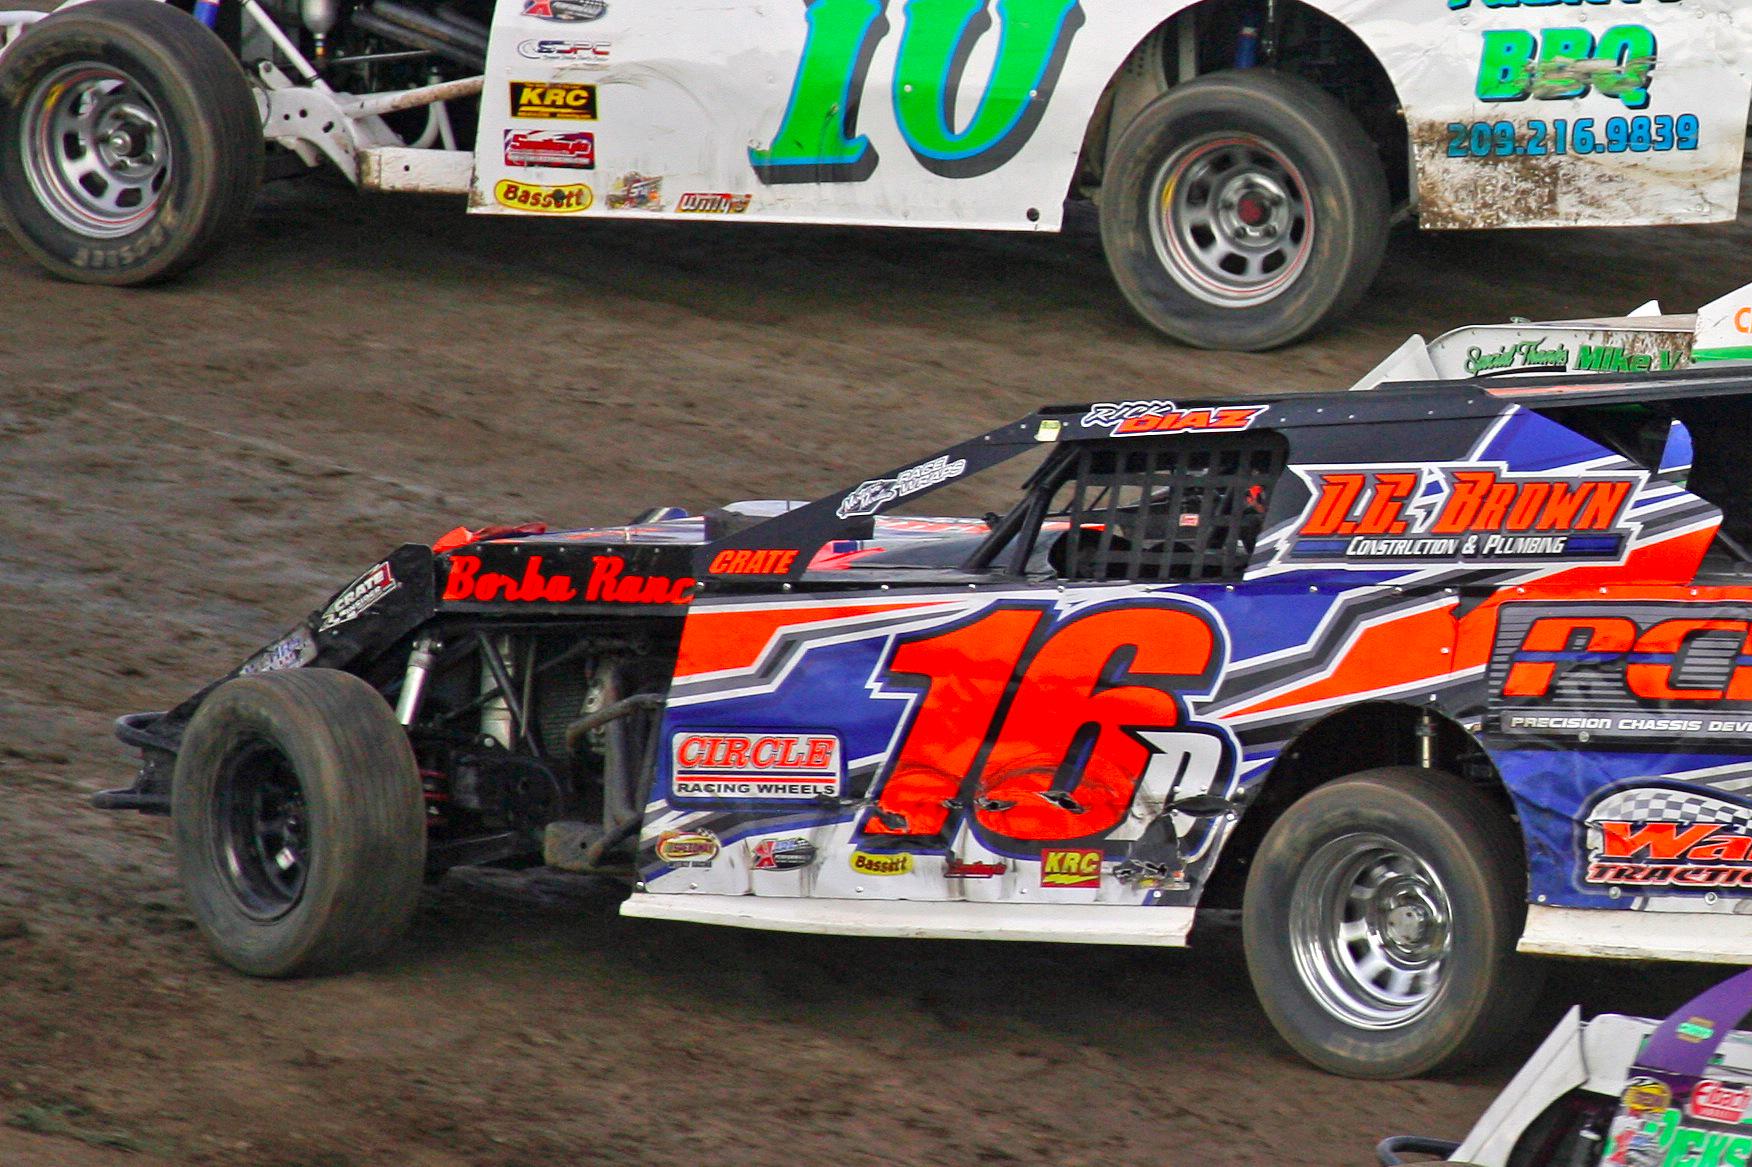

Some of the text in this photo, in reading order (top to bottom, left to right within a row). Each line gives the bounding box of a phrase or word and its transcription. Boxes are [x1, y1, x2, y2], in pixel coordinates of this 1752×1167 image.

[1475, 24, 1658, 109] BBQ
[519, 87, 588, 106] KRC
[748, 0, 1086, 180] 10
[1447, 113, 1699, 158] 209.216.9839
[1084, 403, 1175, 424] RICK
[1113, 409, 1258, 433] DIAZ
[1432, 472, 1633, 535] BROWN
[1346, 537, 1456, 556] CONSTRUCTION
[1461, 538, 1478, 554] &
[708, 549, 799, 574] CRATE
[442, 555, 577, 601] Borba
[334, 570, 386, 612] CRATE
[1511, 717, 1611, 730] PRECISION
[1618, 719, 1701, 732] CHASSIS
[676, 735, 836, 770] CIRCLE
[677, 783, 836, 796] RACING WHEELS
[1045, 852, 1100, 874] KRC
